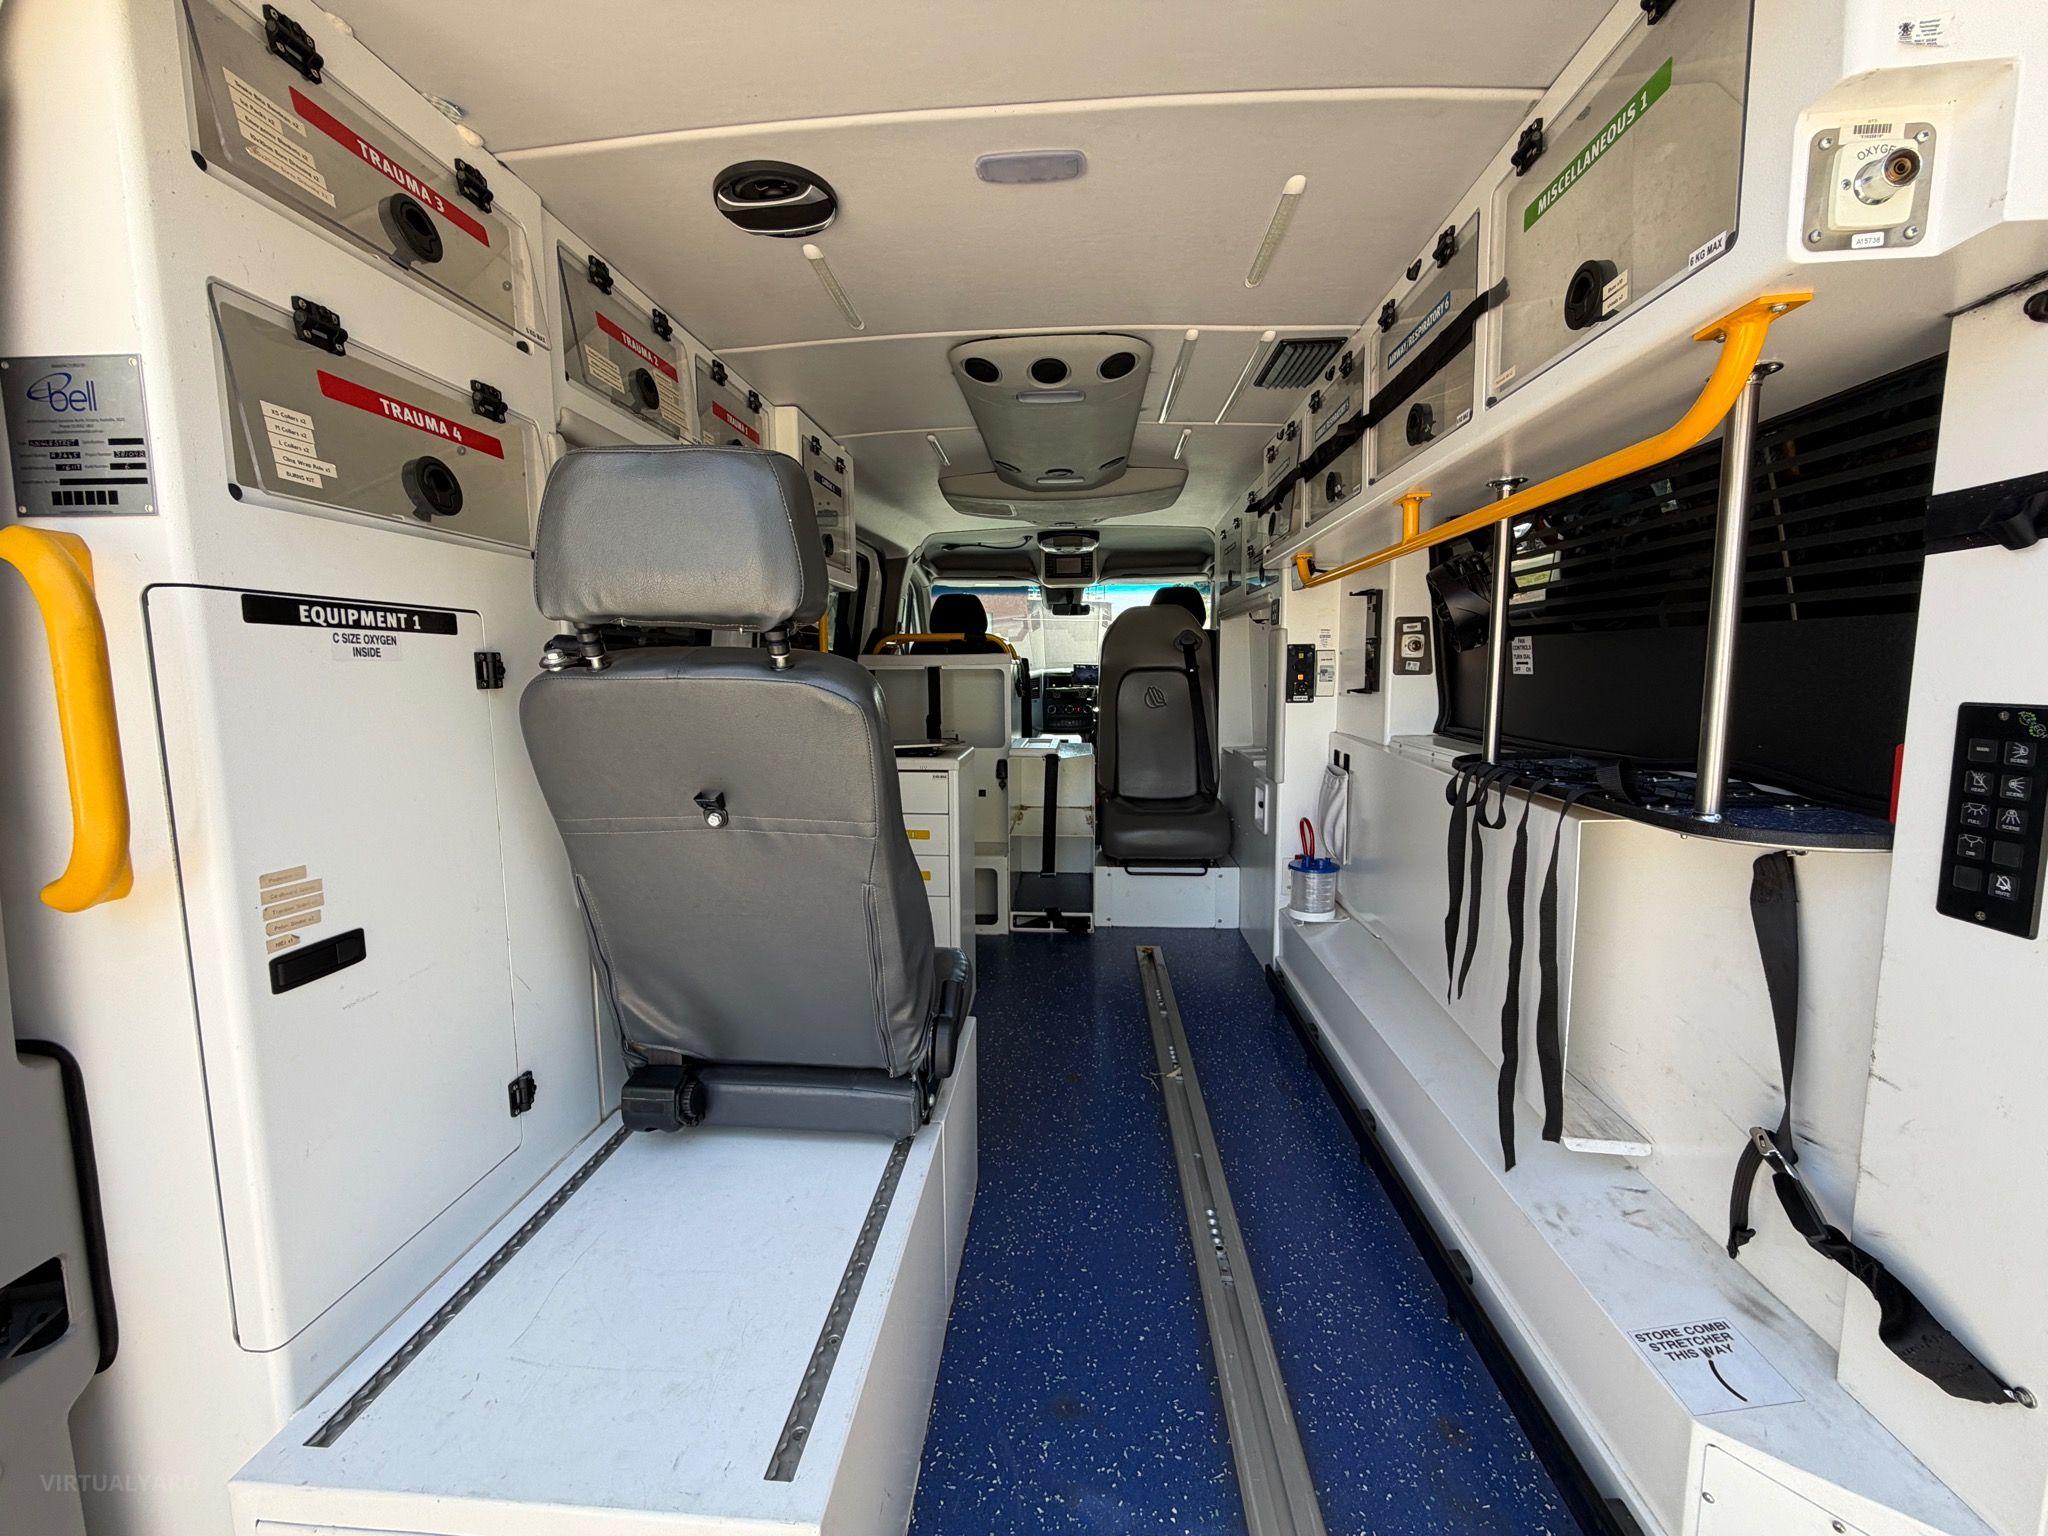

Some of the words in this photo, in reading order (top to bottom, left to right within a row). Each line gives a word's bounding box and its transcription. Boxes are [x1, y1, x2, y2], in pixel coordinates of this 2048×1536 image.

[1537, 103, 1635, 215] MISCELLANEOUS
[1639, 90, 1648, 112] 1
[357, 138, 432, 205] TRAUMA
[433, 196, 445, 213] 3
[1695, 249, 1706, 264] KG
[1707, 237, 1723, 256] MAX
[621, 332, 655, 363] TRAUMA
[379, 397, 450, 438] TRAUMA
[452, 425, 463, 442] 4
[298, 604, 408, 629] EQUIPMENT
[412, 615, 421, 630] 1
[332, 632, 340, 644] C
[341, 633, 362, 645] SIZE
[363, 634, 397, 646] OXYGEN
[352, 646, 382, 658] INSIDE
[1634, 1328, 1682, 1343] STORE
[1683, 1320, 1731, 1336] COMBI
[1648, 1332, 1735, 1352] STRETCHER
[1664, 1346, 1700, 1362] THIS
[1700, 1343, 1735, 1360] WAY
